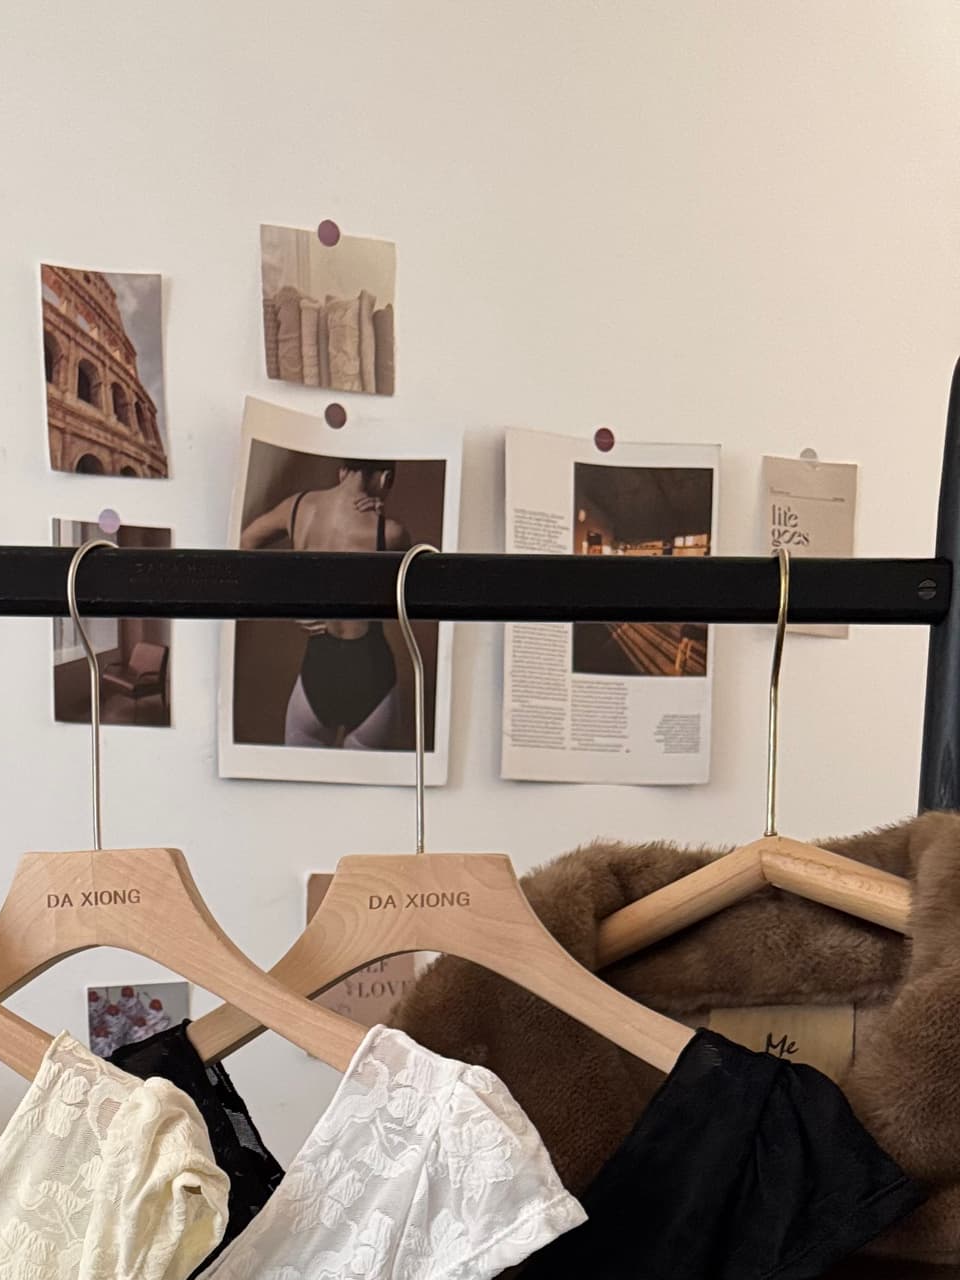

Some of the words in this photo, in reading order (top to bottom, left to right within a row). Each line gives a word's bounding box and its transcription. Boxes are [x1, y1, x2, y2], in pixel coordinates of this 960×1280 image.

[47, 893, 74, 909] DA
[80, 888, 141, 907] XIONG
[368, 894, 397, 910] DA
[406, 891, 471, 909] XIONG
